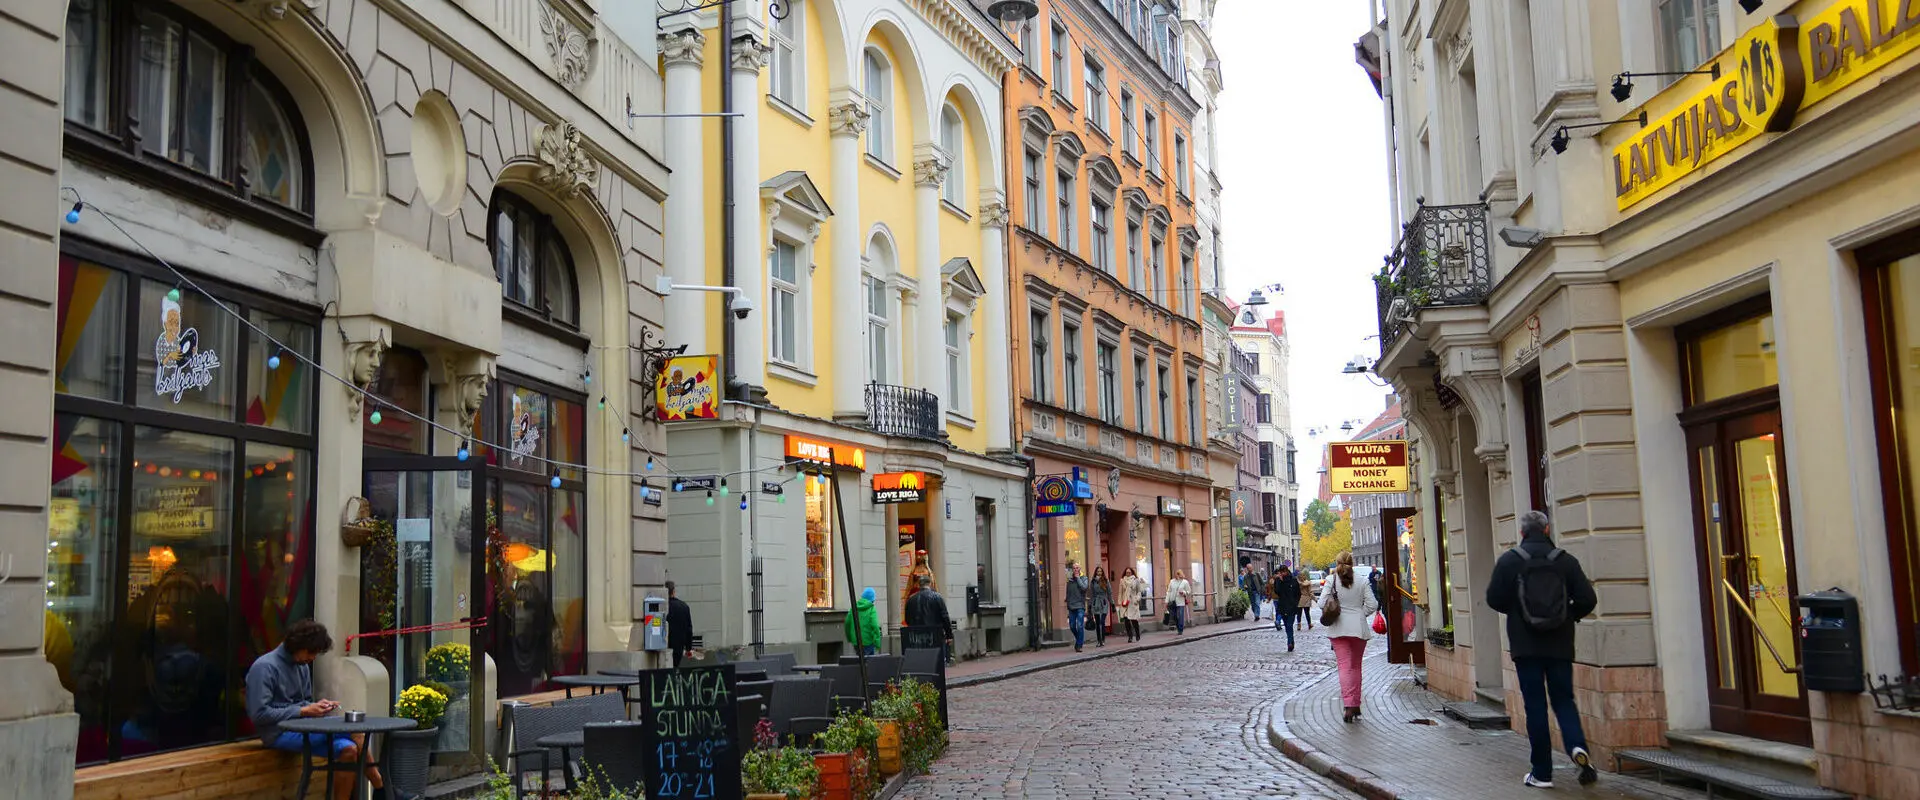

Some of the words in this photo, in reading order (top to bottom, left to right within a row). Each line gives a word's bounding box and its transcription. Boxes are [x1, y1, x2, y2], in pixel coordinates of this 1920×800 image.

[1613, 80, 1742, 198] LATVIJAS
[1227, 377, 1236, 422] HOTEL
[798, 441, 817, 457] LOVE
[1353, 469, 1388, 477] MONEY
[1343, 480, 1396, 489] EXCHANGE
[877, 491, 898, 499] LOVE
[899, 490, 919, 498] RIGA
